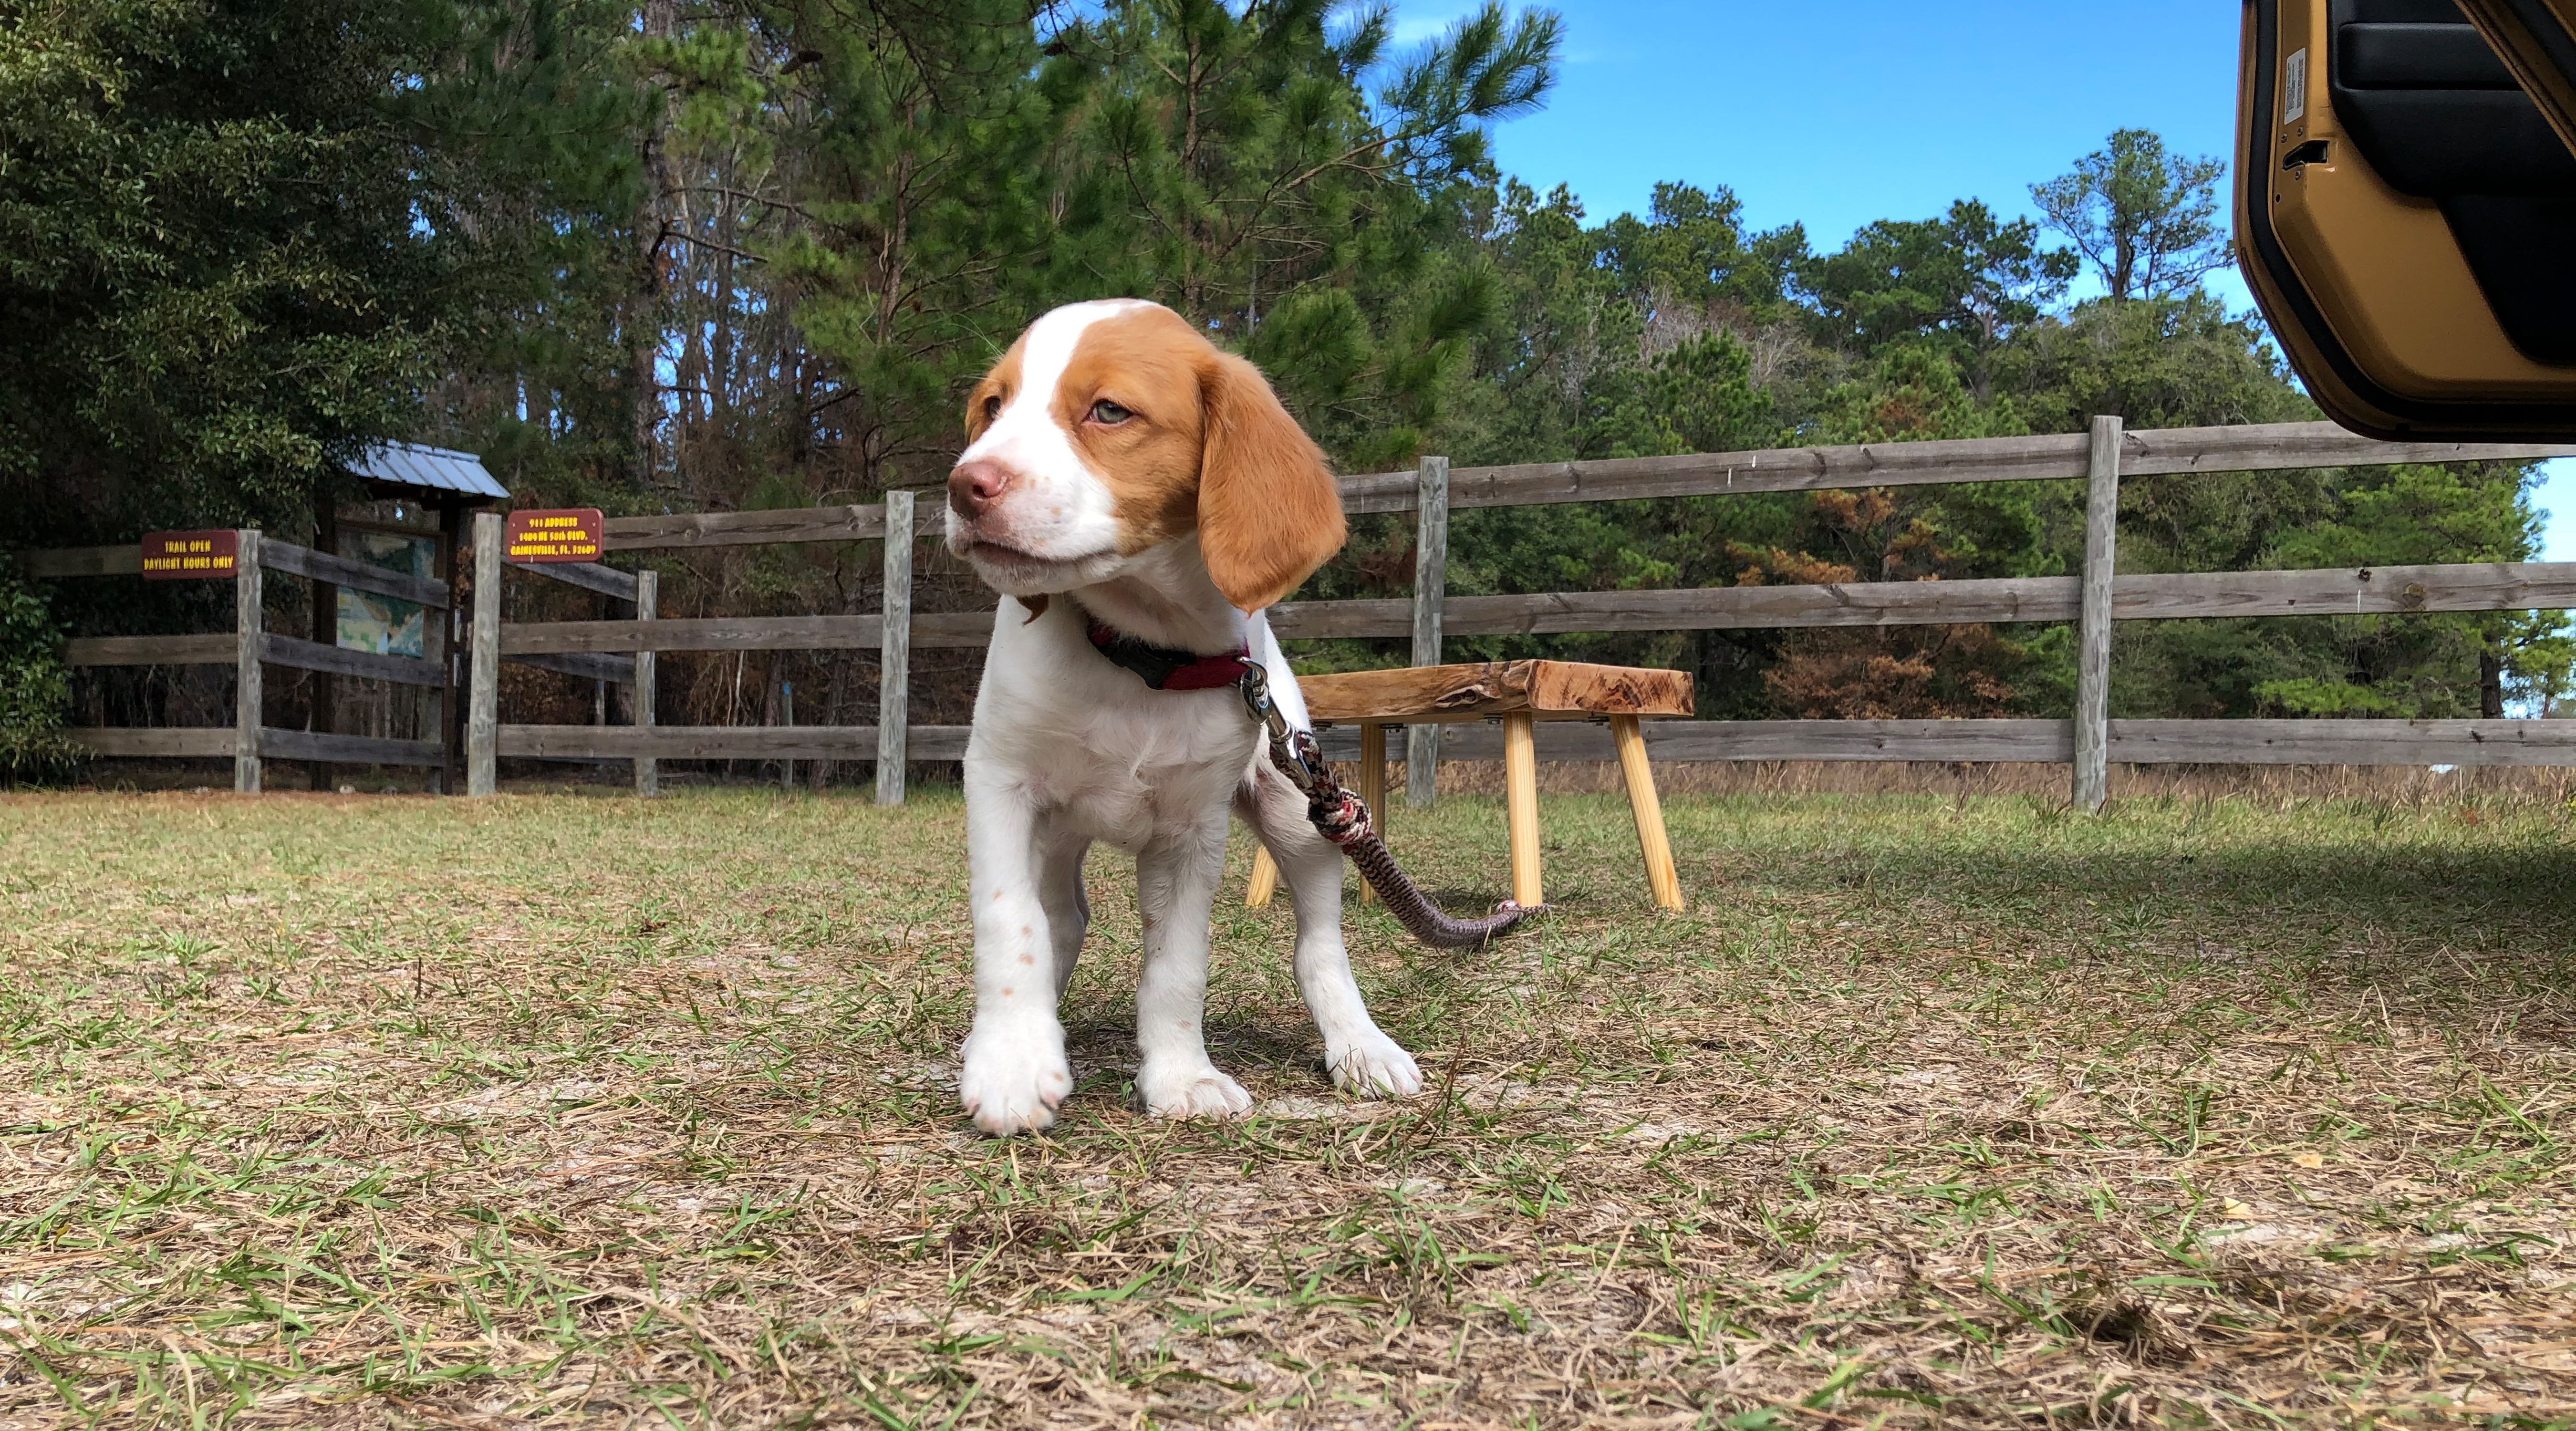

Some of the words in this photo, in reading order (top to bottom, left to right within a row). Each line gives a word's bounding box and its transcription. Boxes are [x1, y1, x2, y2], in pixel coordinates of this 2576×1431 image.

[529, 518, 543, 528] 911
[545, 518, 577, 527] ADDRESS
[567, 531, 588, 540] BLVD.
[165, 541, 187, 553] TRAIL
[190, 540, 210, 552] OPEN
[510, 545, 558, 555] GAINESVILLE,
[560, 545, 570, 554] FL.
[145, 558, 180, 570] DAYLIGHT
[184, 557, 210, 569] HOURS
[213, 556, 233, 568] ONLY
